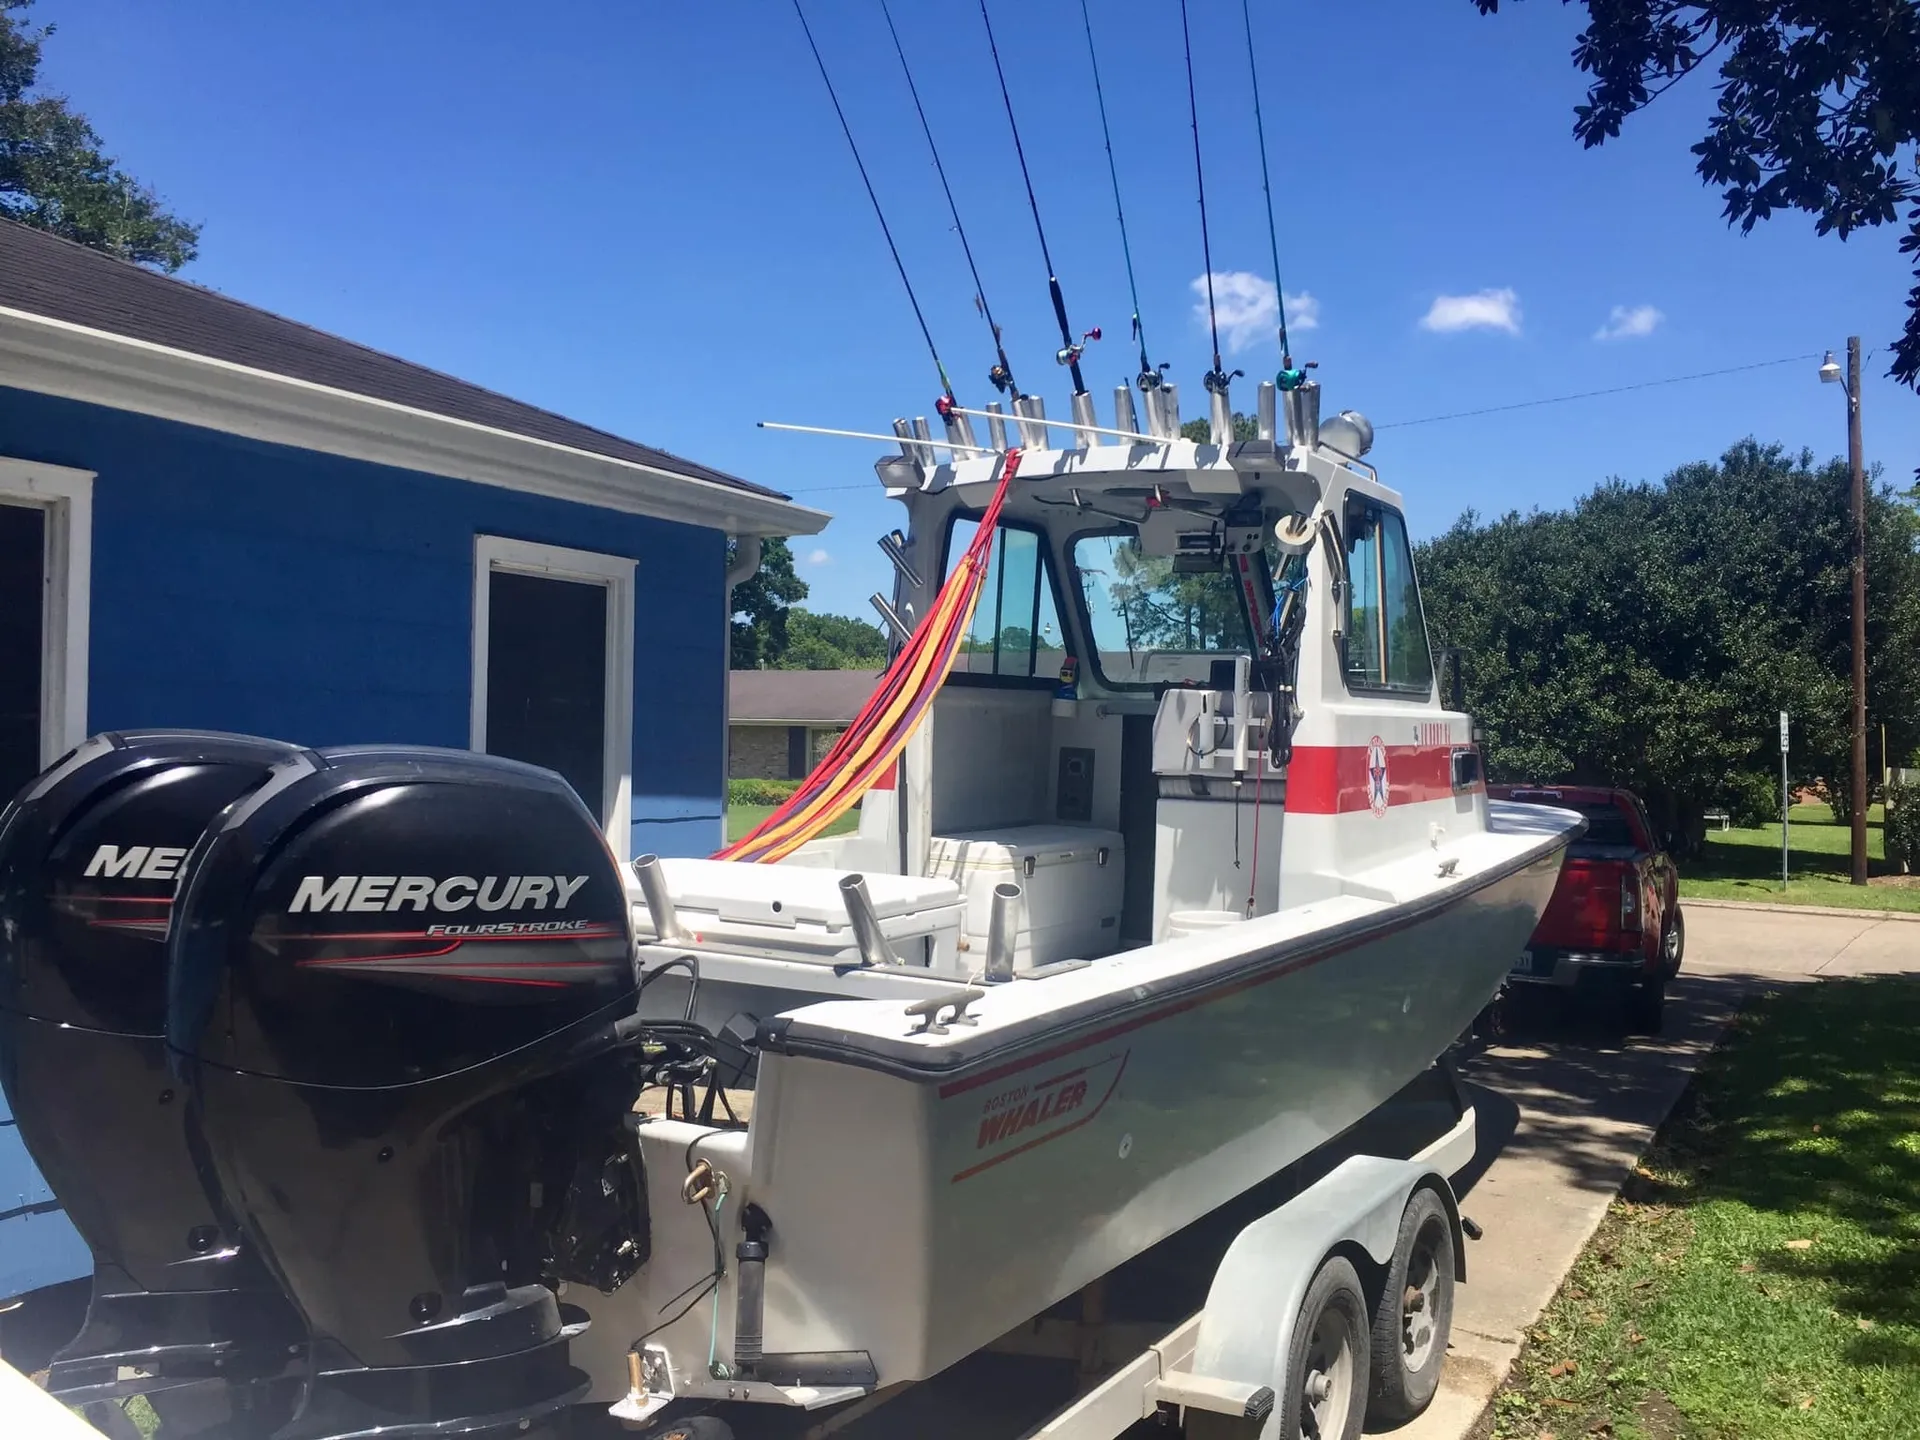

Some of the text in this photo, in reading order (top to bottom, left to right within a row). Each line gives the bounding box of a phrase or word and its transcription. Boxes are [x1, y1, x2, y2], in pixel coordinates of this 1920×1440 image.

[83, 844, 188, 880] ME
[288, 875, 590, 913] MERCURY
[976, 1079, 1088, 1150] WHALER
[982, 1083, 1029, 1115] BOSTON
